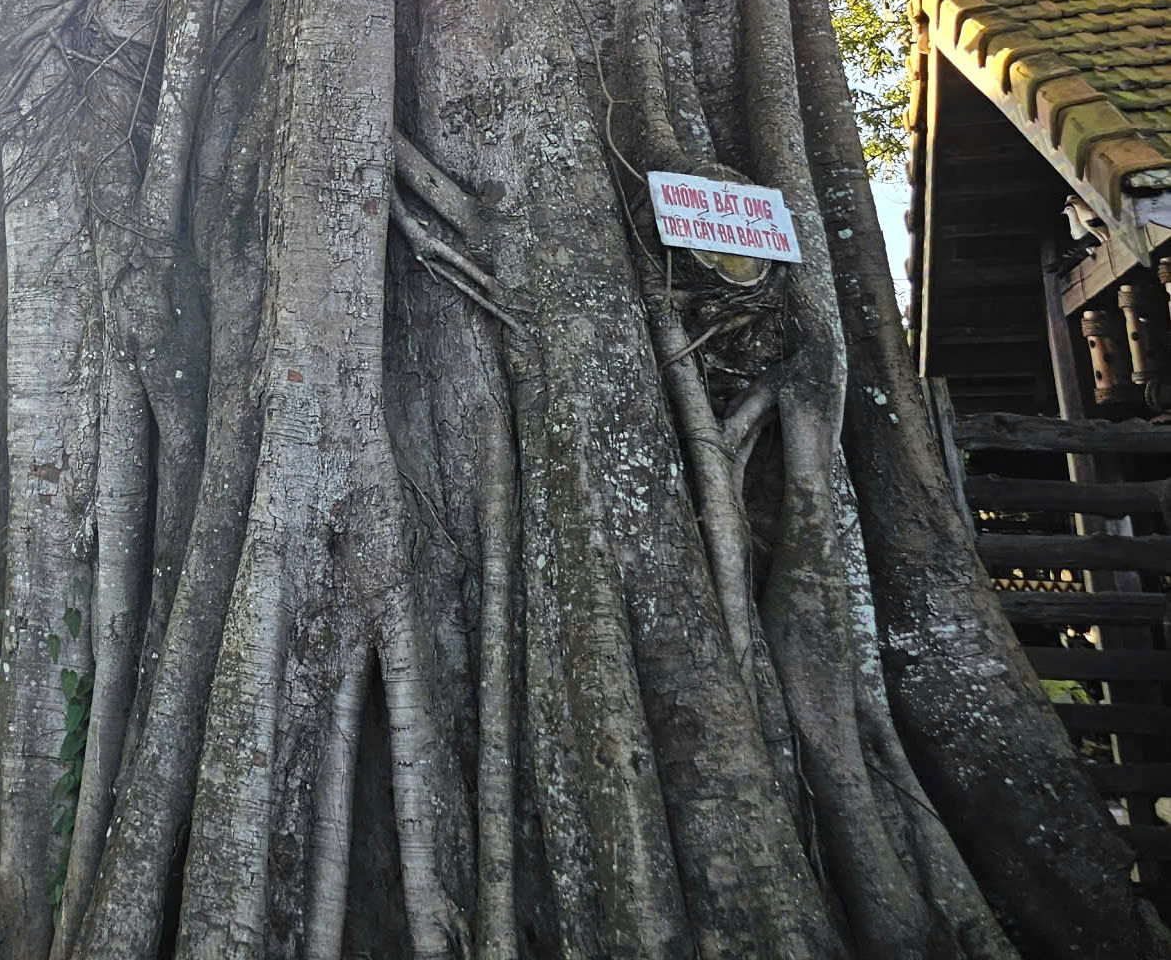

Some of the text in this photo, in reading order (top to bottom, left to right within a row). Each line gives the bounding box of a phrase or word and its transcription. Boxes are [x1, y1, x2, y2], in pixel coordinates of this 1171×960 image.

[660, 182, 773, 221] KHÔNG BẮT ONG
[660, 214, 791, 252] TRÊN CÂY ĐA BẢO TỒN
